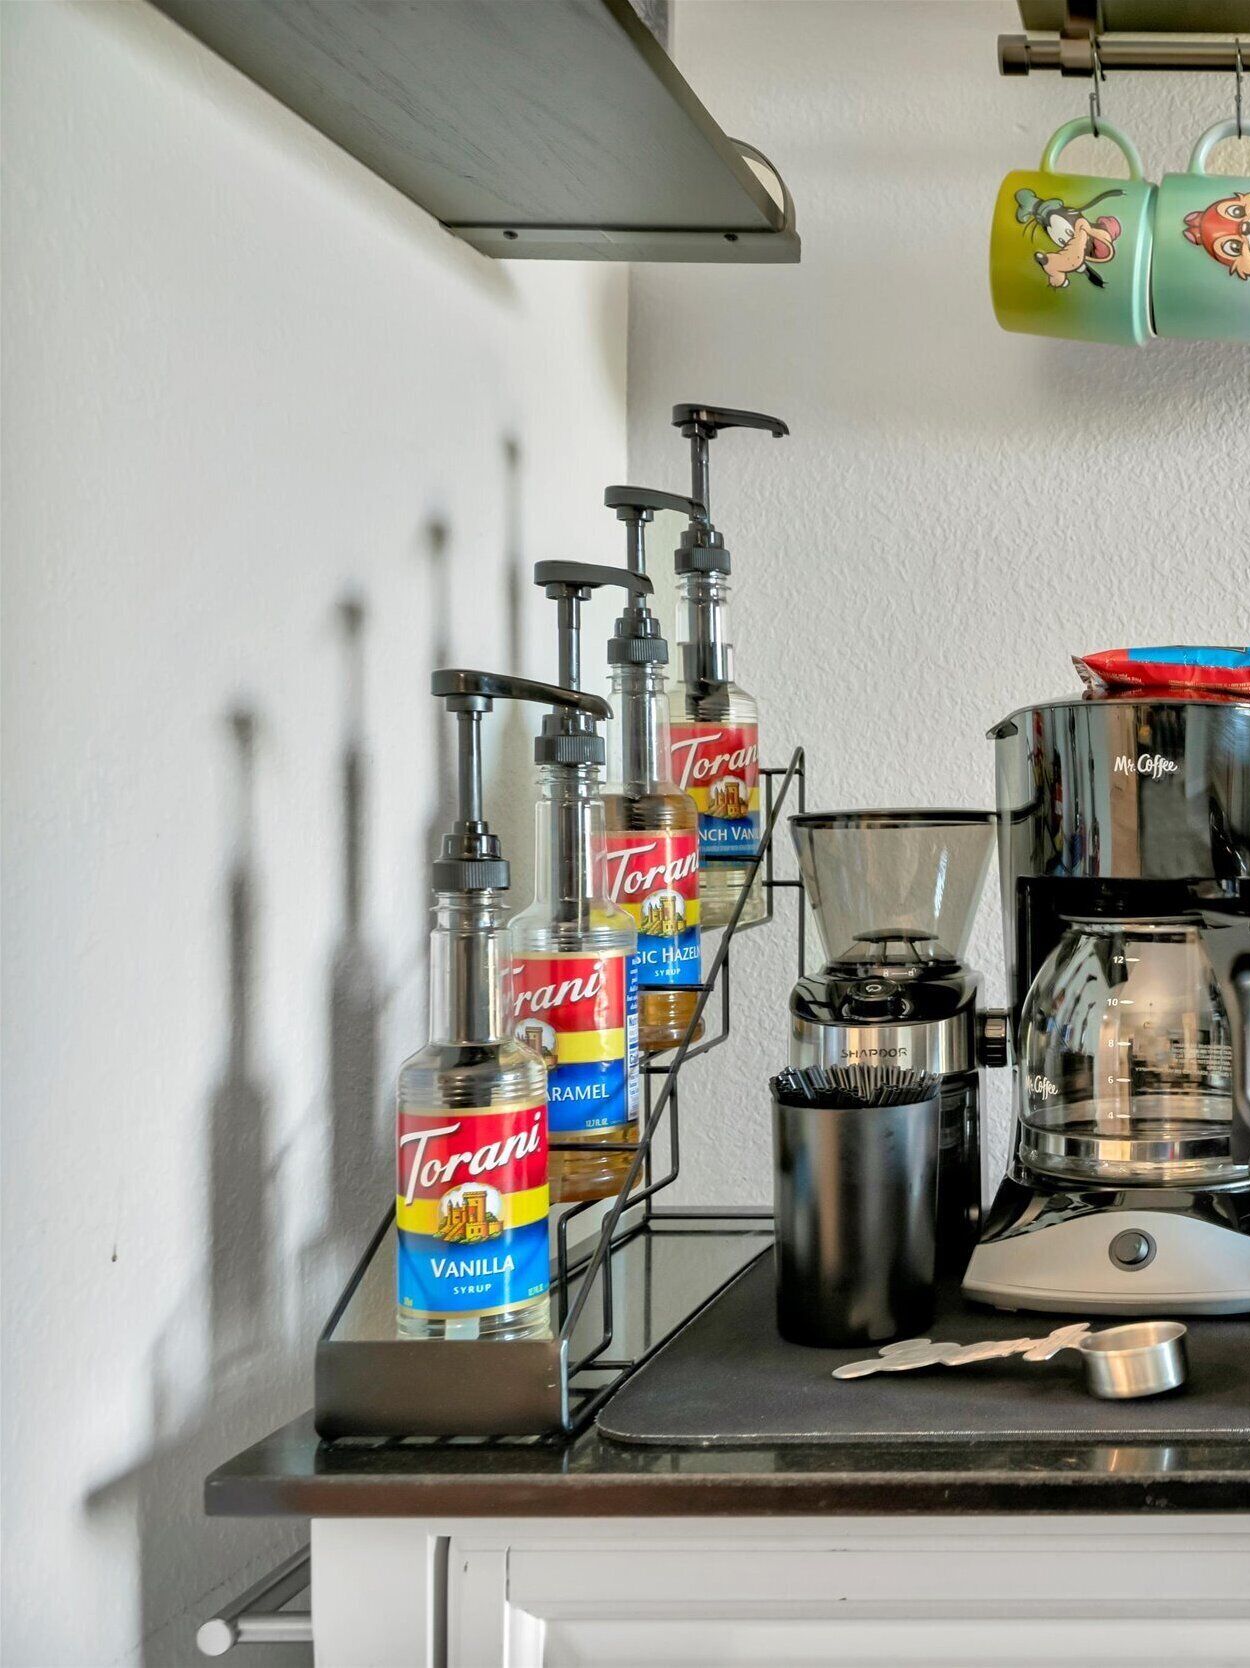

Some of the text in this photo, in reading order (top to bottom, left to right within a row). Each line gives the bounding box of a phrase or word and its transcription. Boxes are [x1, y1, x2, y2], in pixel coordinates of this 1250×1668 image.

[671, 732, 758, 791] Toran
[1114, 753, 1178, 779] Mr. Coffee
[698, 828, 728, 841] NCH
[598, 842, 699, 903] Toran
[1113, 956, 1124, 964] 12
[654, 968, 681, 977] SYRUP
[1107, 998, 1118, 1006] 10
[1108, 1039, 1114, 1047] 8
[1108, 1076, 1114, 1084] 6
[548, 1084, 610, 1101] RAMEL
[1034, 1075, 1059, 1100] Coffee
[1108, 1111, 1114, 1119] 4
[400, 1112, 542, 1206] Torani
[430, 1254, 515, 1278] VANILLA
[453, 1283, 492, 1295] SYRUP
